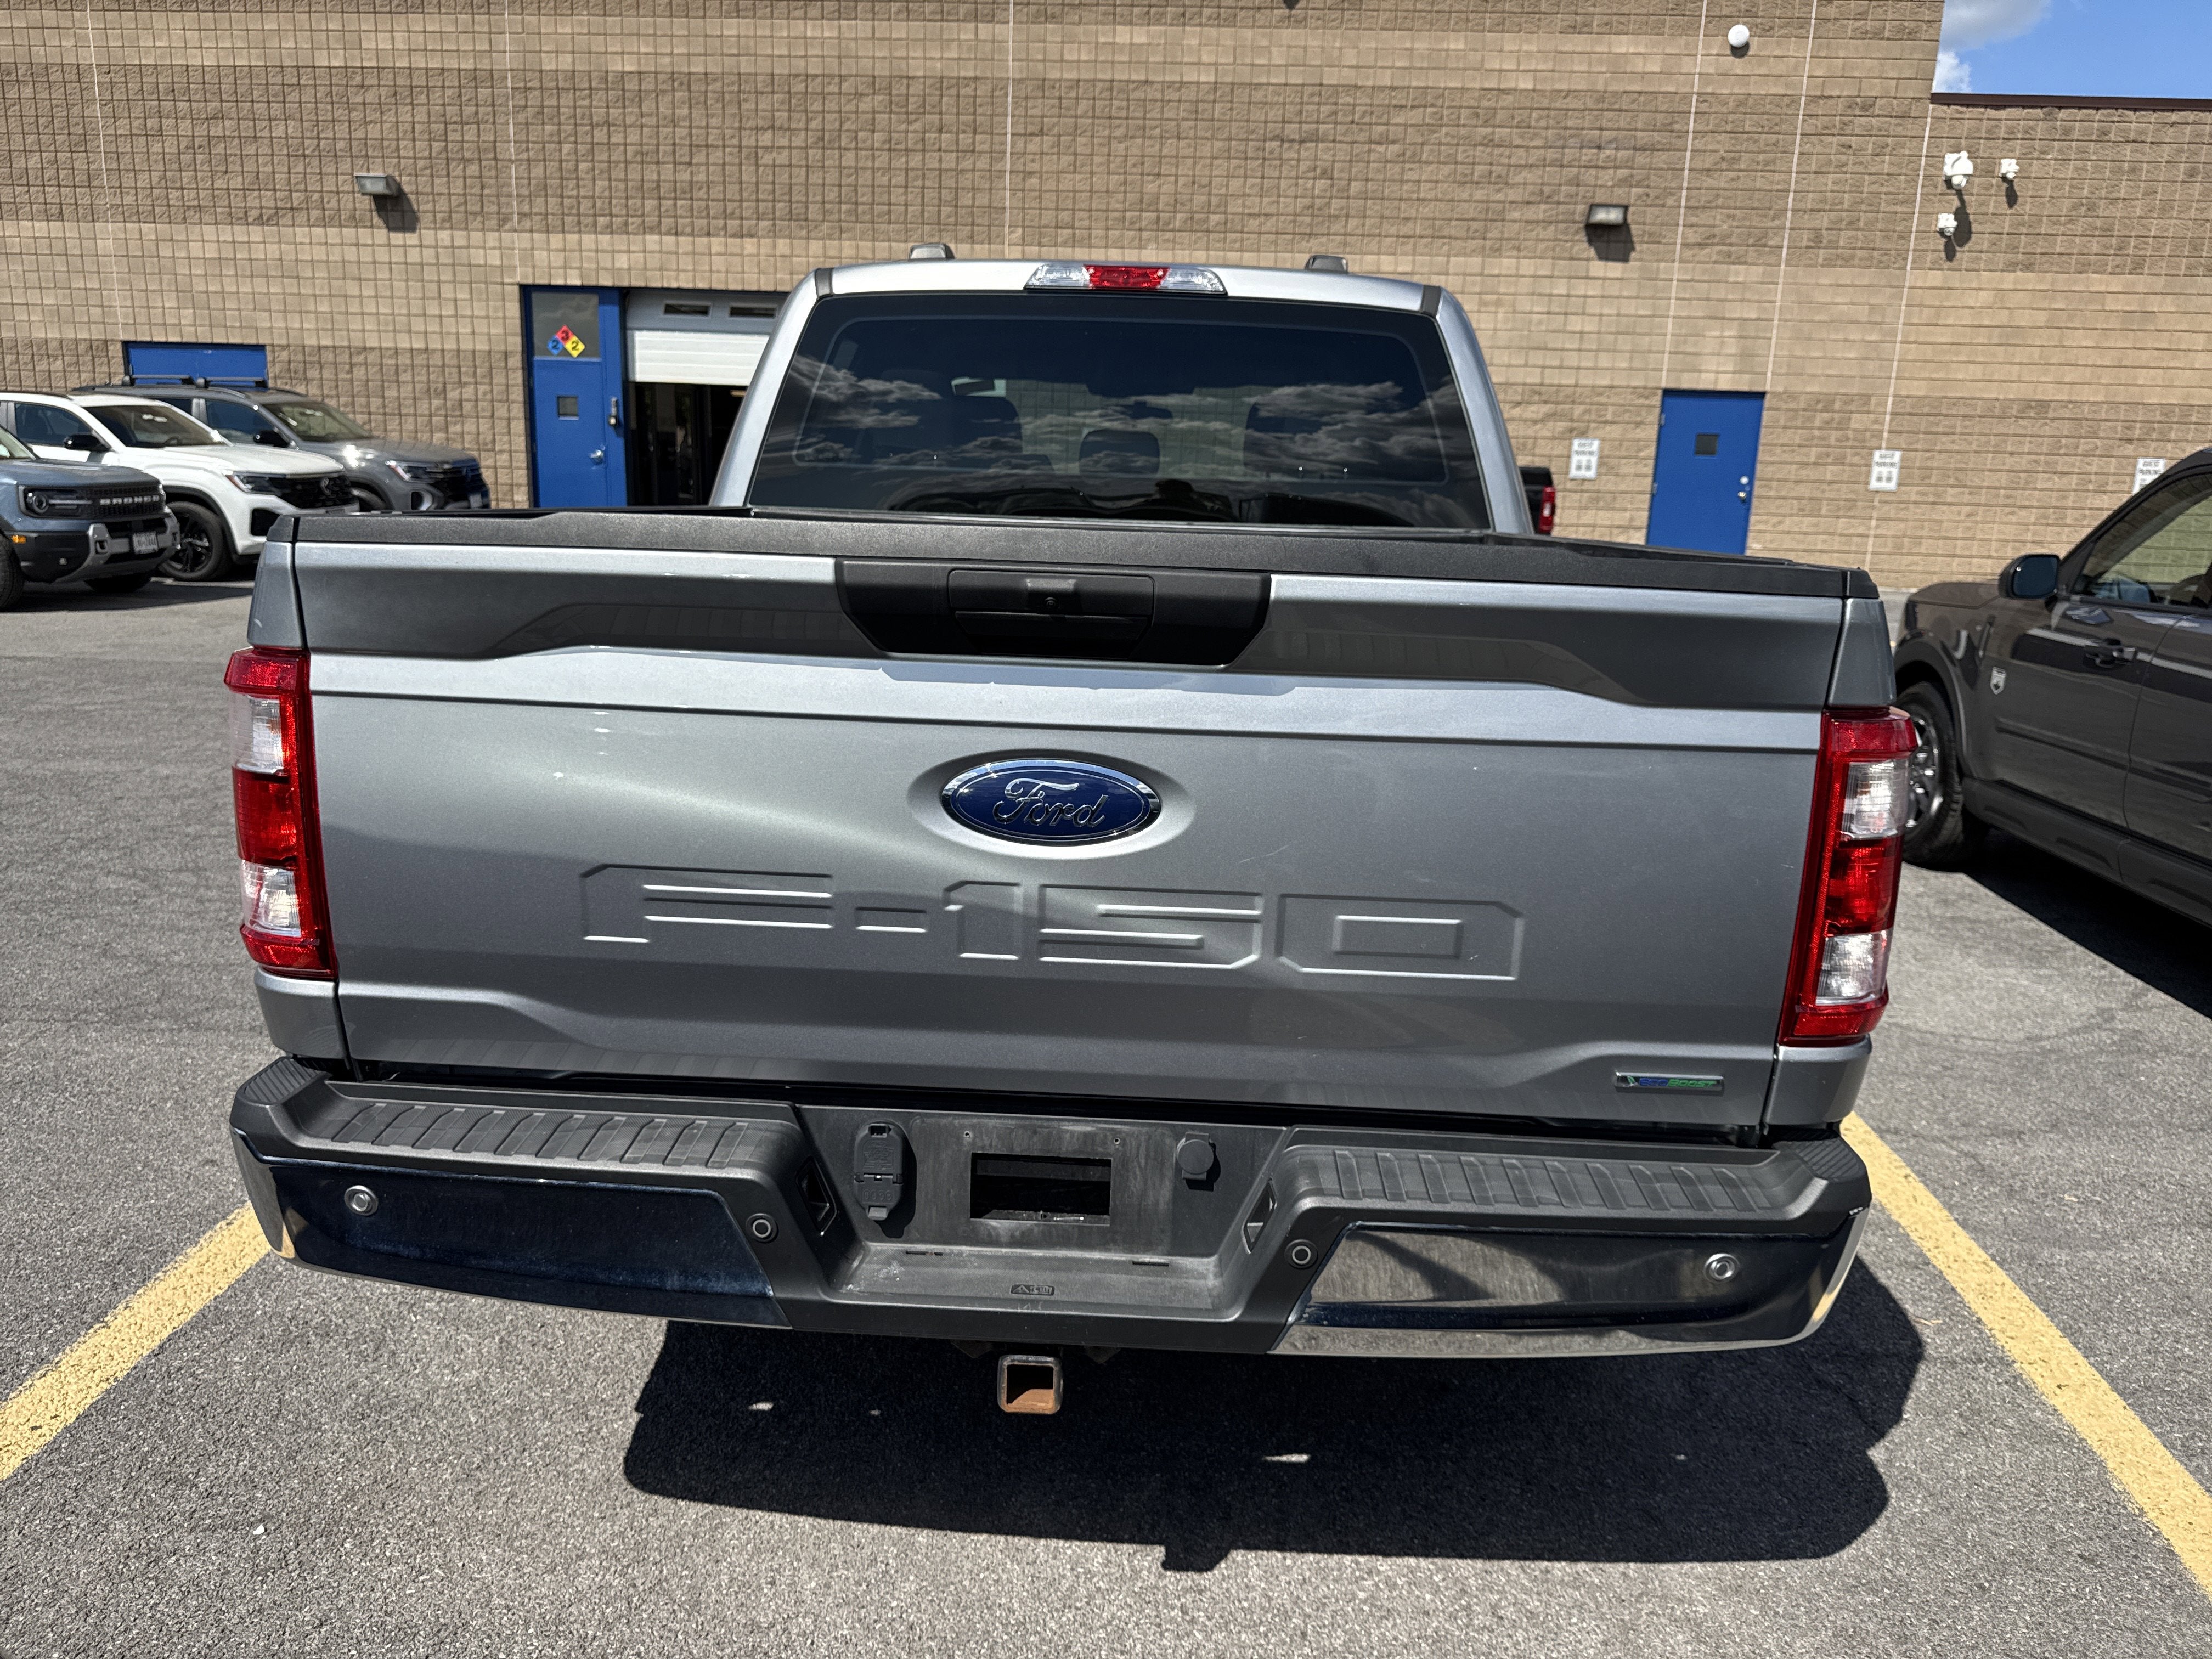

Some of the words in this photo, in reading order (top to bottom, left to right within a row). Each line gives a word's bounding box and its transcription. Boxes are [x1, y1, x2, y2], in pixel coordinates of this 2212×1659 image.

[561, 330, 569, 341] 3
[552, 340, 560, 349] 2
[572, 341, 579, 351] 2
[100, 495, 160, 505] BRONCO
[992, 777, 1108, 828] Ford
[580, 863, 1524, 981] F-150
